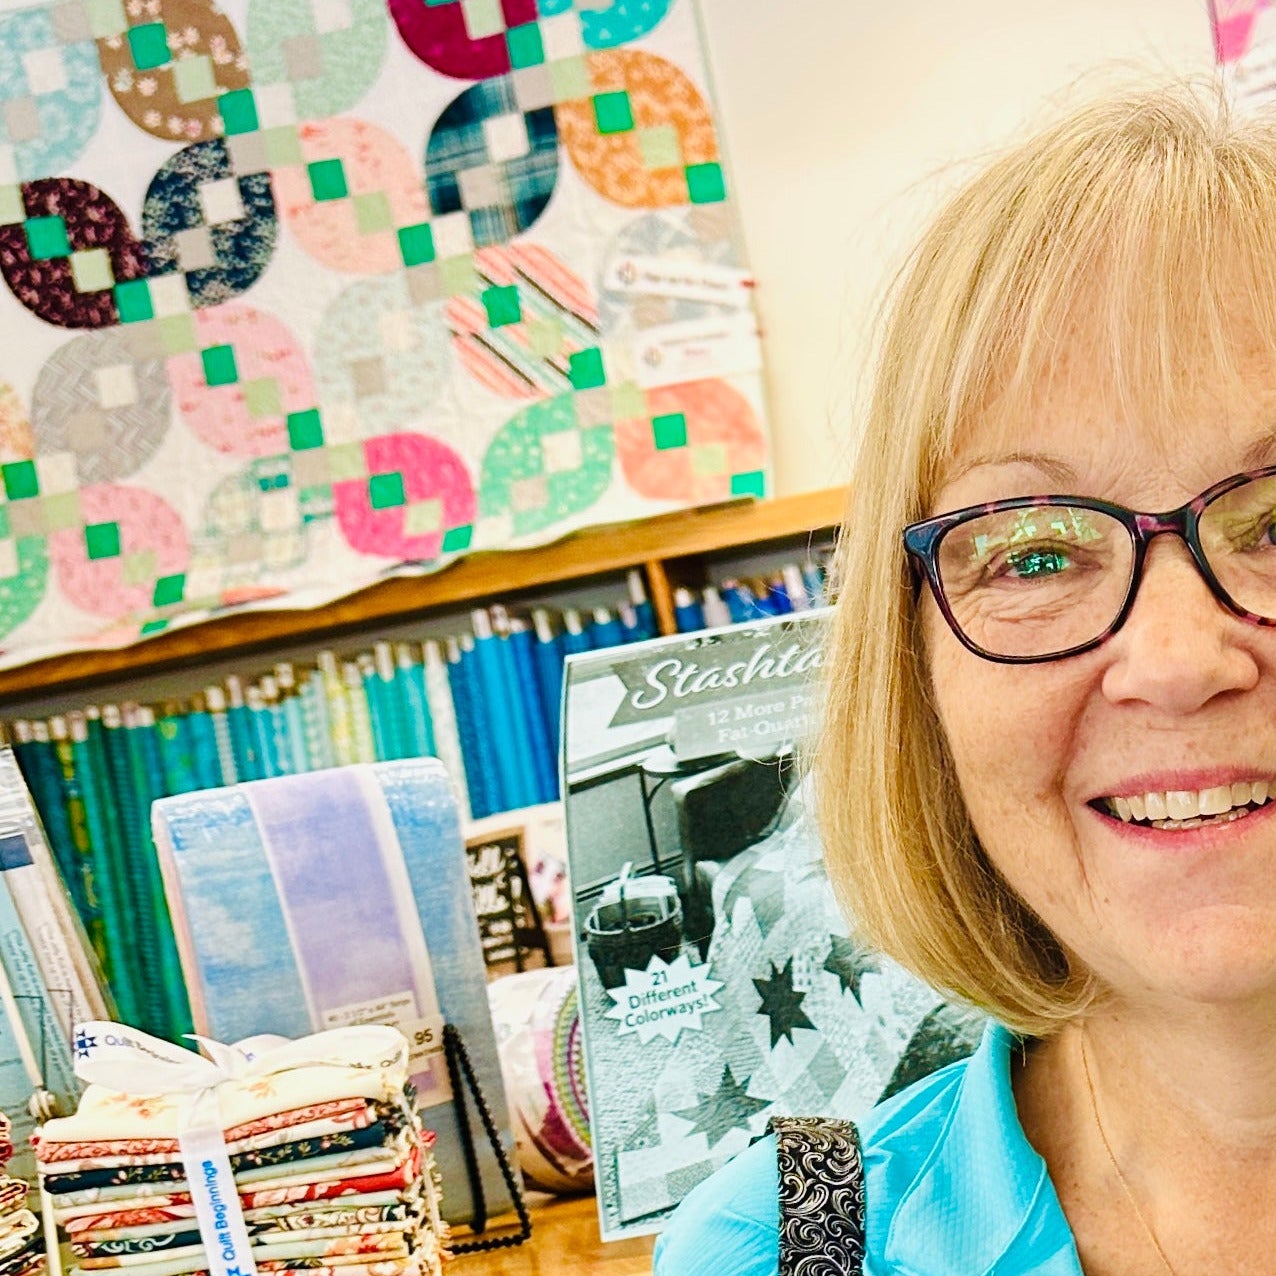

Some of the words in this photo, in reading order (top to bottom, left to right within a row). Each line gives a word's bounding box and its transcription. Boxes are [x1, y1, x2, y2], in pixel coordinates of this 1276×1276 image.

[631, 644, 824, 710] Stashta
[707, 708, 729, 726] 12
[735, 700, 785, 721] More
[718, 713, 812, 743] Fat-Quart
[652, 970, 668, 986] 21
[629, 981, 698, 1009] Different
[625, 994, 707, 1027] Colorways!
[201, 1160, 228, 1230] Beginnings
[218, 1231, 236, 1262] Quilt
